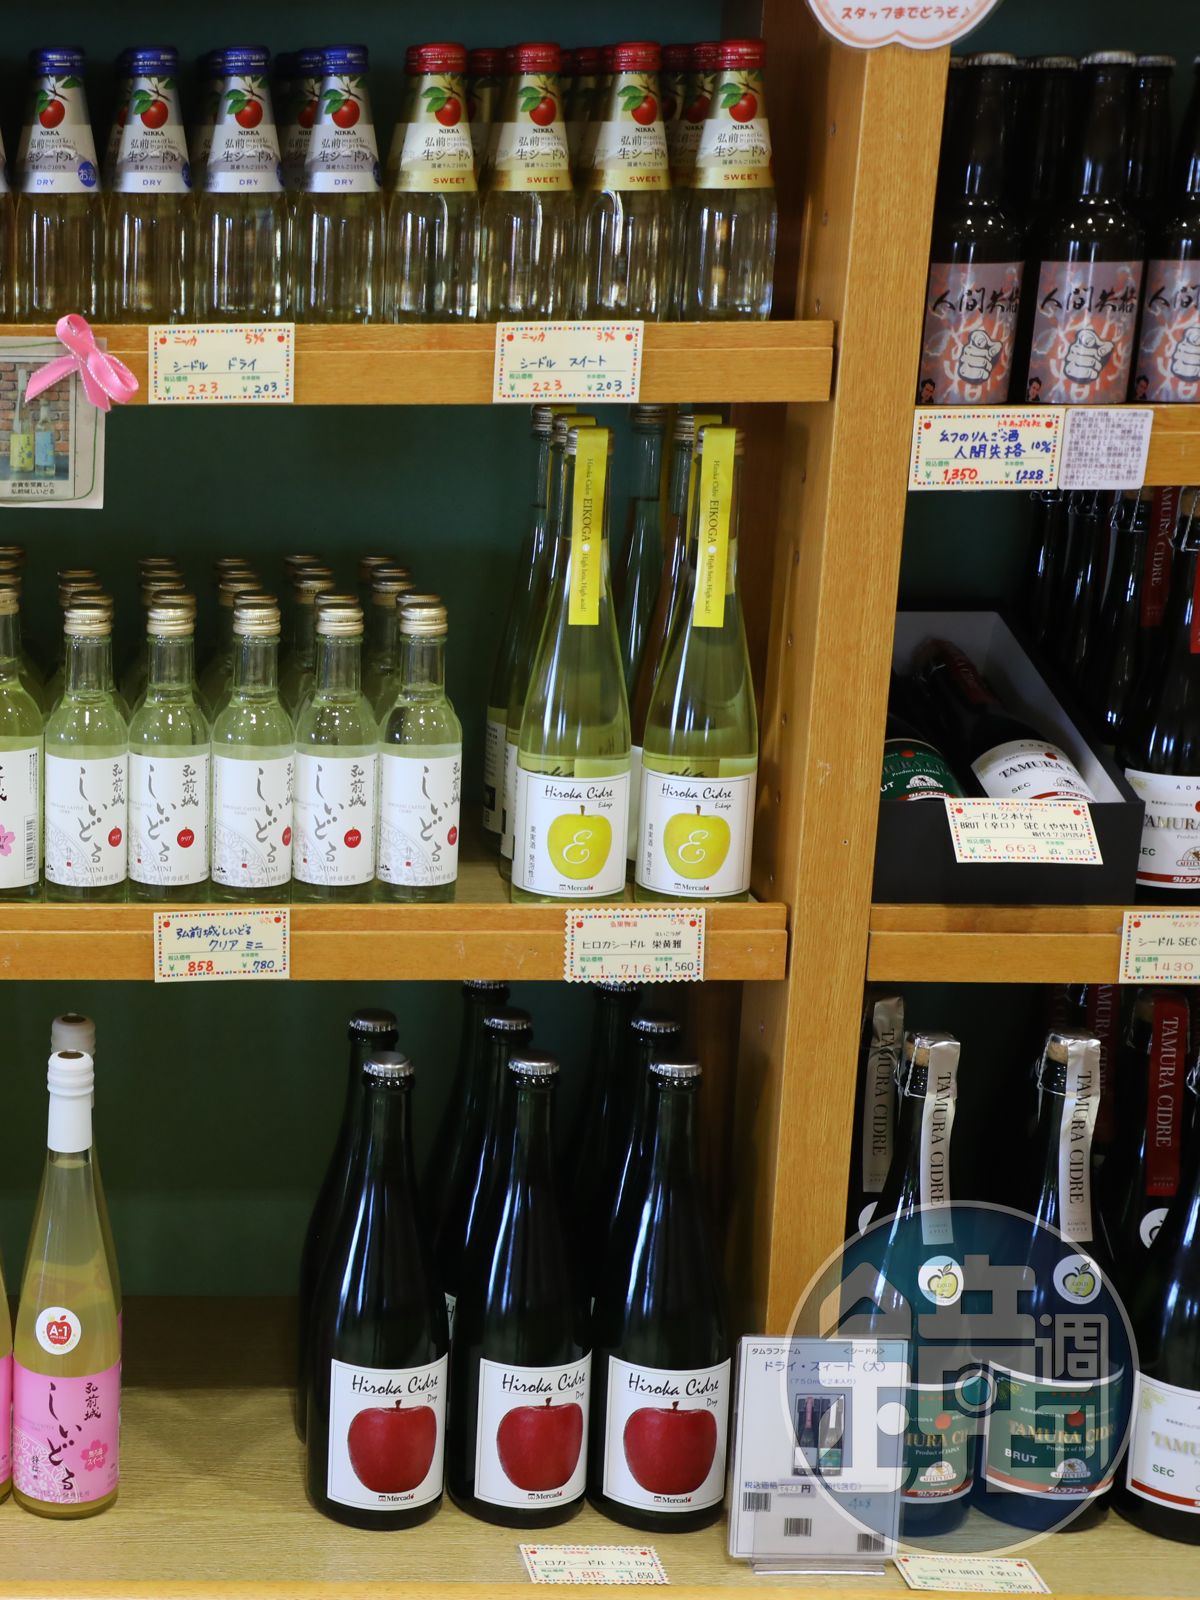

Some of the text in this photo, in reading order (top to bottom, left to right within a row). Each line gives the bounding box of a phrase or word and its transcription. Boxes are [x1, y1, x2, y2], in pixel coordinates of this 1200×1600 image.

[629, 175, 661, 183] SWEET
[723, 173, 758, 181] SWEET
[174, 336, 197, 346] ニッカ
[521, 332, 545, 342] ニッカ
[173, 357, 257, 372] シードル ドライ
[521, 356, 606, 369] シードル スイート
[188, 382, 218, 394] 223
[254, 382, 277, 393] 203
[533, 380, 562, 392] 223
[597, 380, 622, 391] 203
[581, 498, 593, 542] EIKOGA
[708, 500, 719, 544] EIKOGA
[545, 785, 613, 799] Hiroka Cidre
[661, 783, 732, 799] Hiroka Cidre
[1011, 782, 1031, 793] SEC
[209, 940, 263, 951] クリア ミニ
[582, 940, 645, 949] ヒロカシードル
[188, 960, 214, 972] 858
[253, 960, 275, 970] 780
[1156, 1017, 1179, 1147] TAMURA CIDRE
[930, 1072, 952, 1206] TAMURA CIDRE
[1069, 1071, 1091, 1204] TAMURA CIDRE
[50, 1327, 68, 1336] A-1
[352, 1374, 438, 1394] Hiroka Cidre
[502, 1372, 586, 1392] Hiroka Cidre
[629, 1373, 719, 1396] Hiroka Cidre
[1004, 1448, 1038, 1464] BRUT
[1152, 1464, 1175, 1477] SEC
